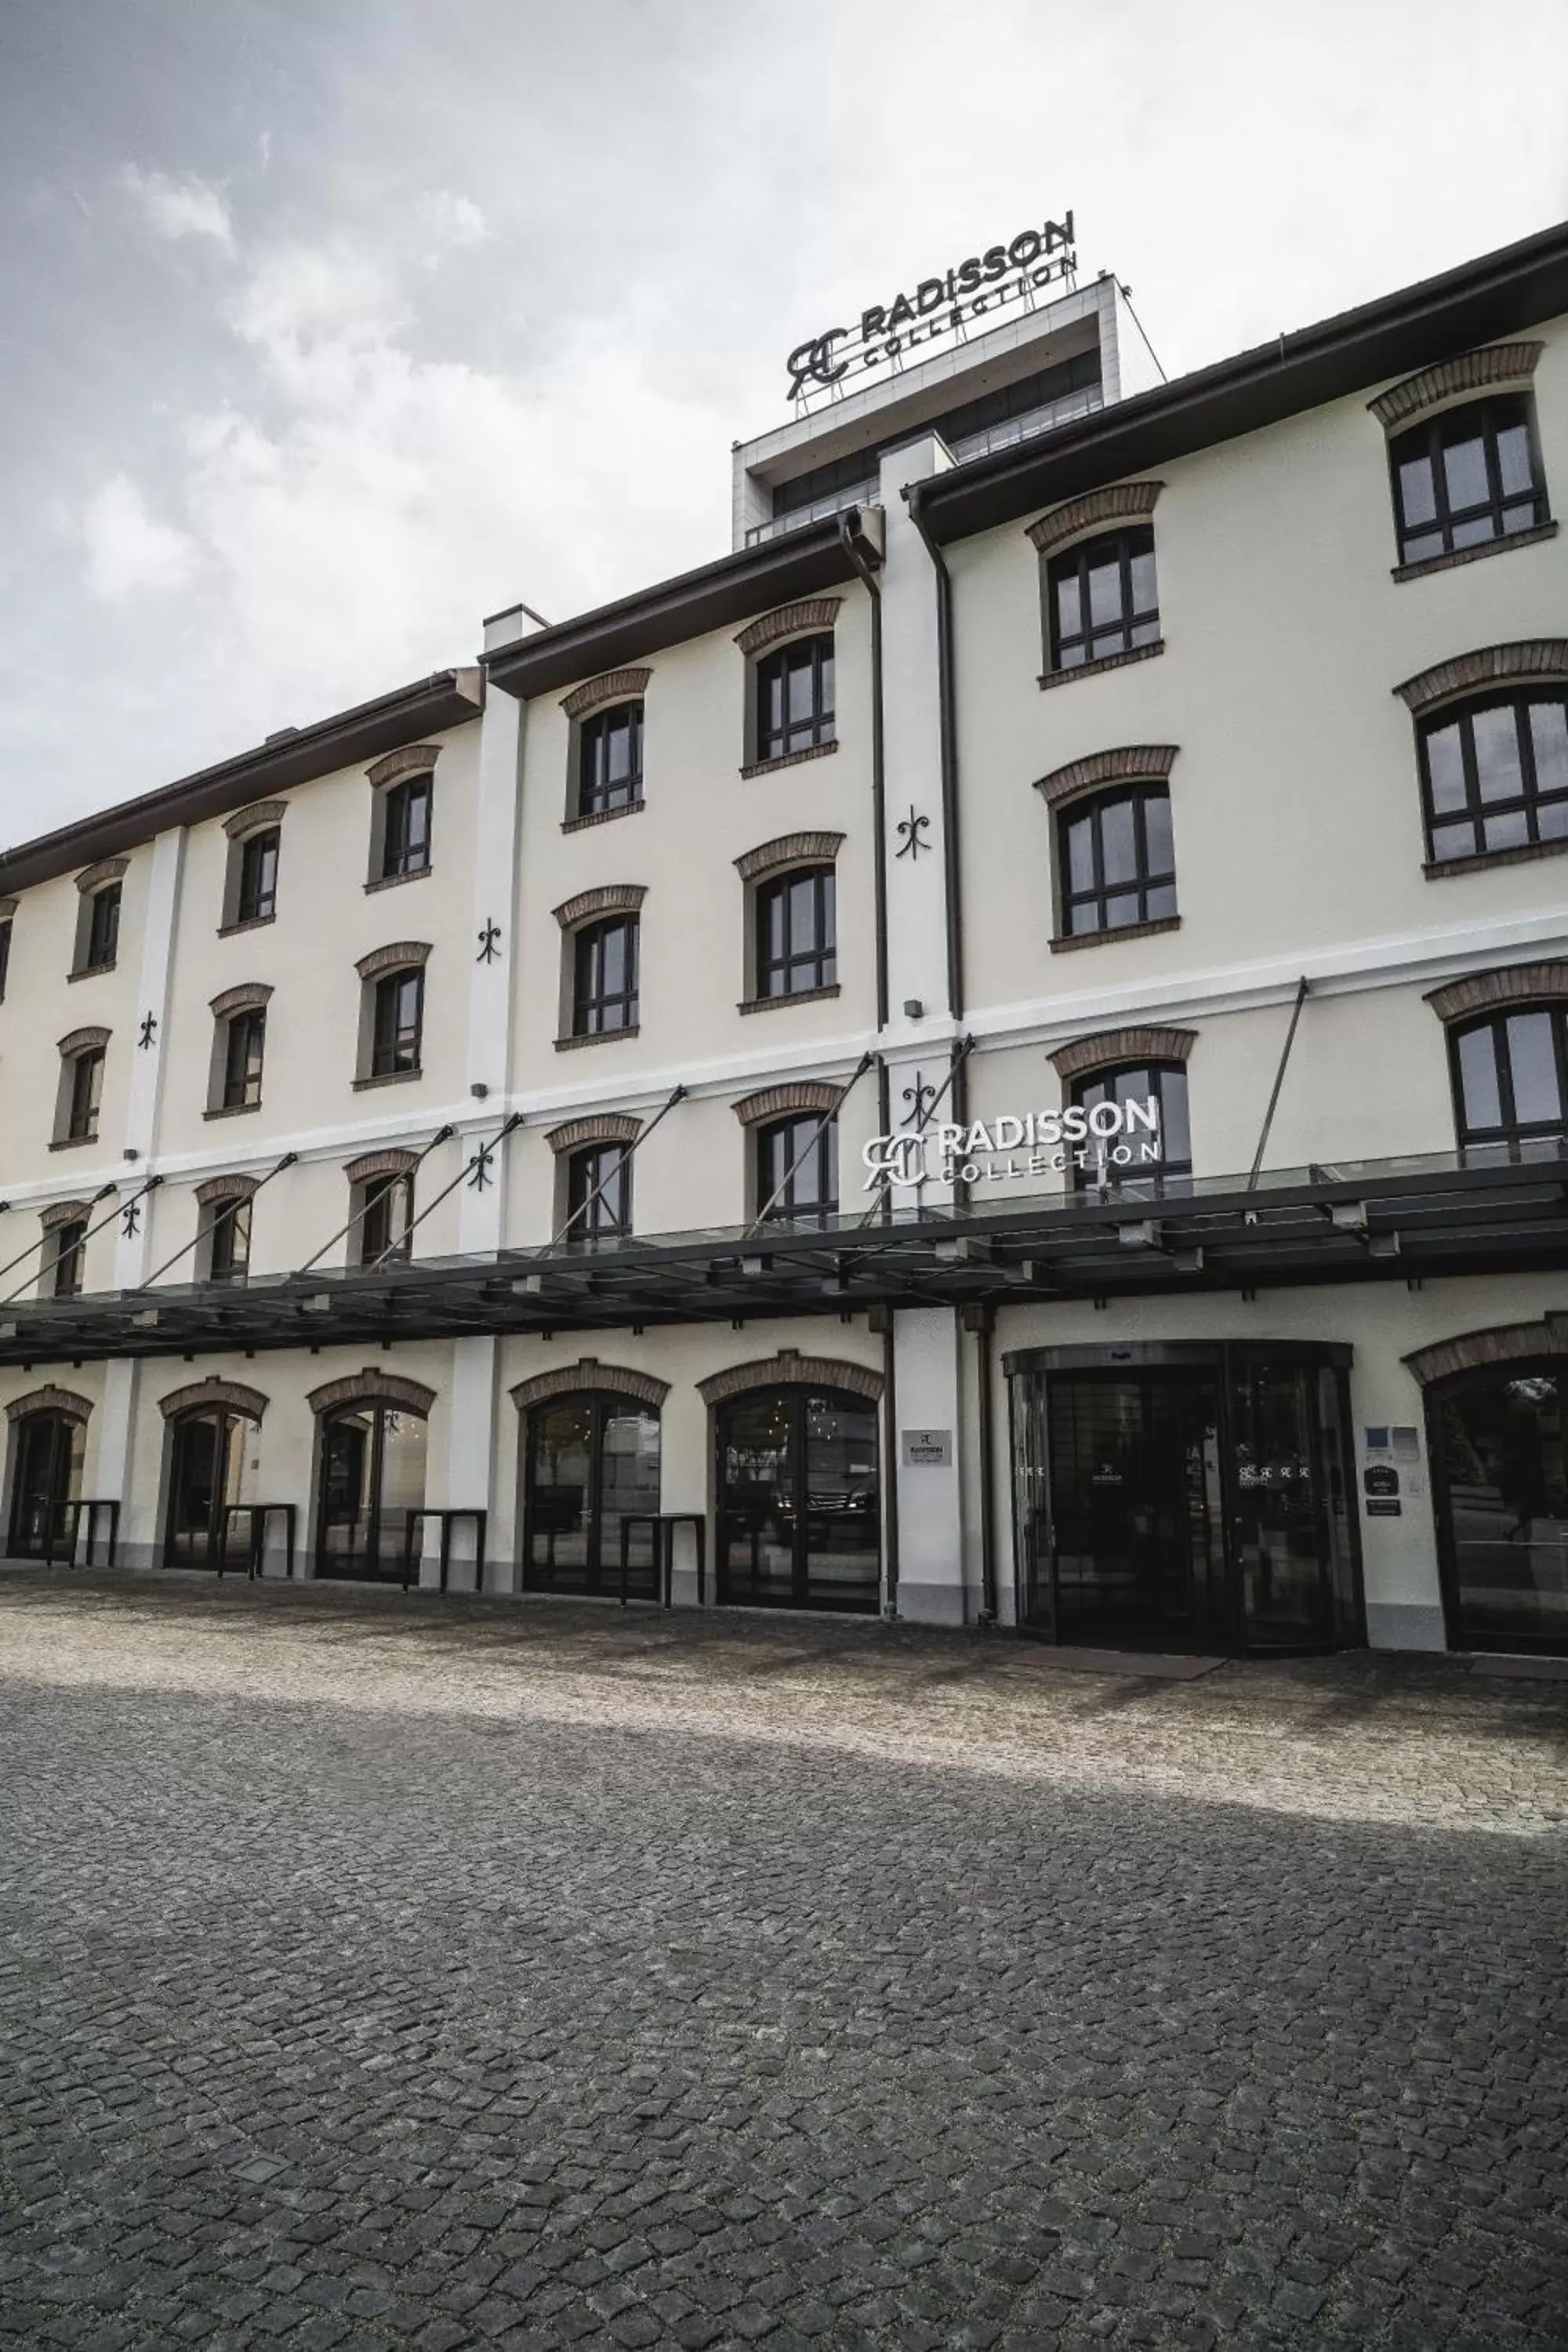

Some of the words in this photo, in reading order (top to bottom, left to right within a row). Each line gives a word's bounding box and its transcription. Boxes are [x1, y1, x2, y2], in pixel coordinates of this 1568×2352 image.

[861, 210, 1076, 343] RADISSON
[863, 251, 1078, 368] COLLECTION
[938, 1095, 1159, 1157] RADISSON
[939, 1142, 1162, 1185] COLLECTION
